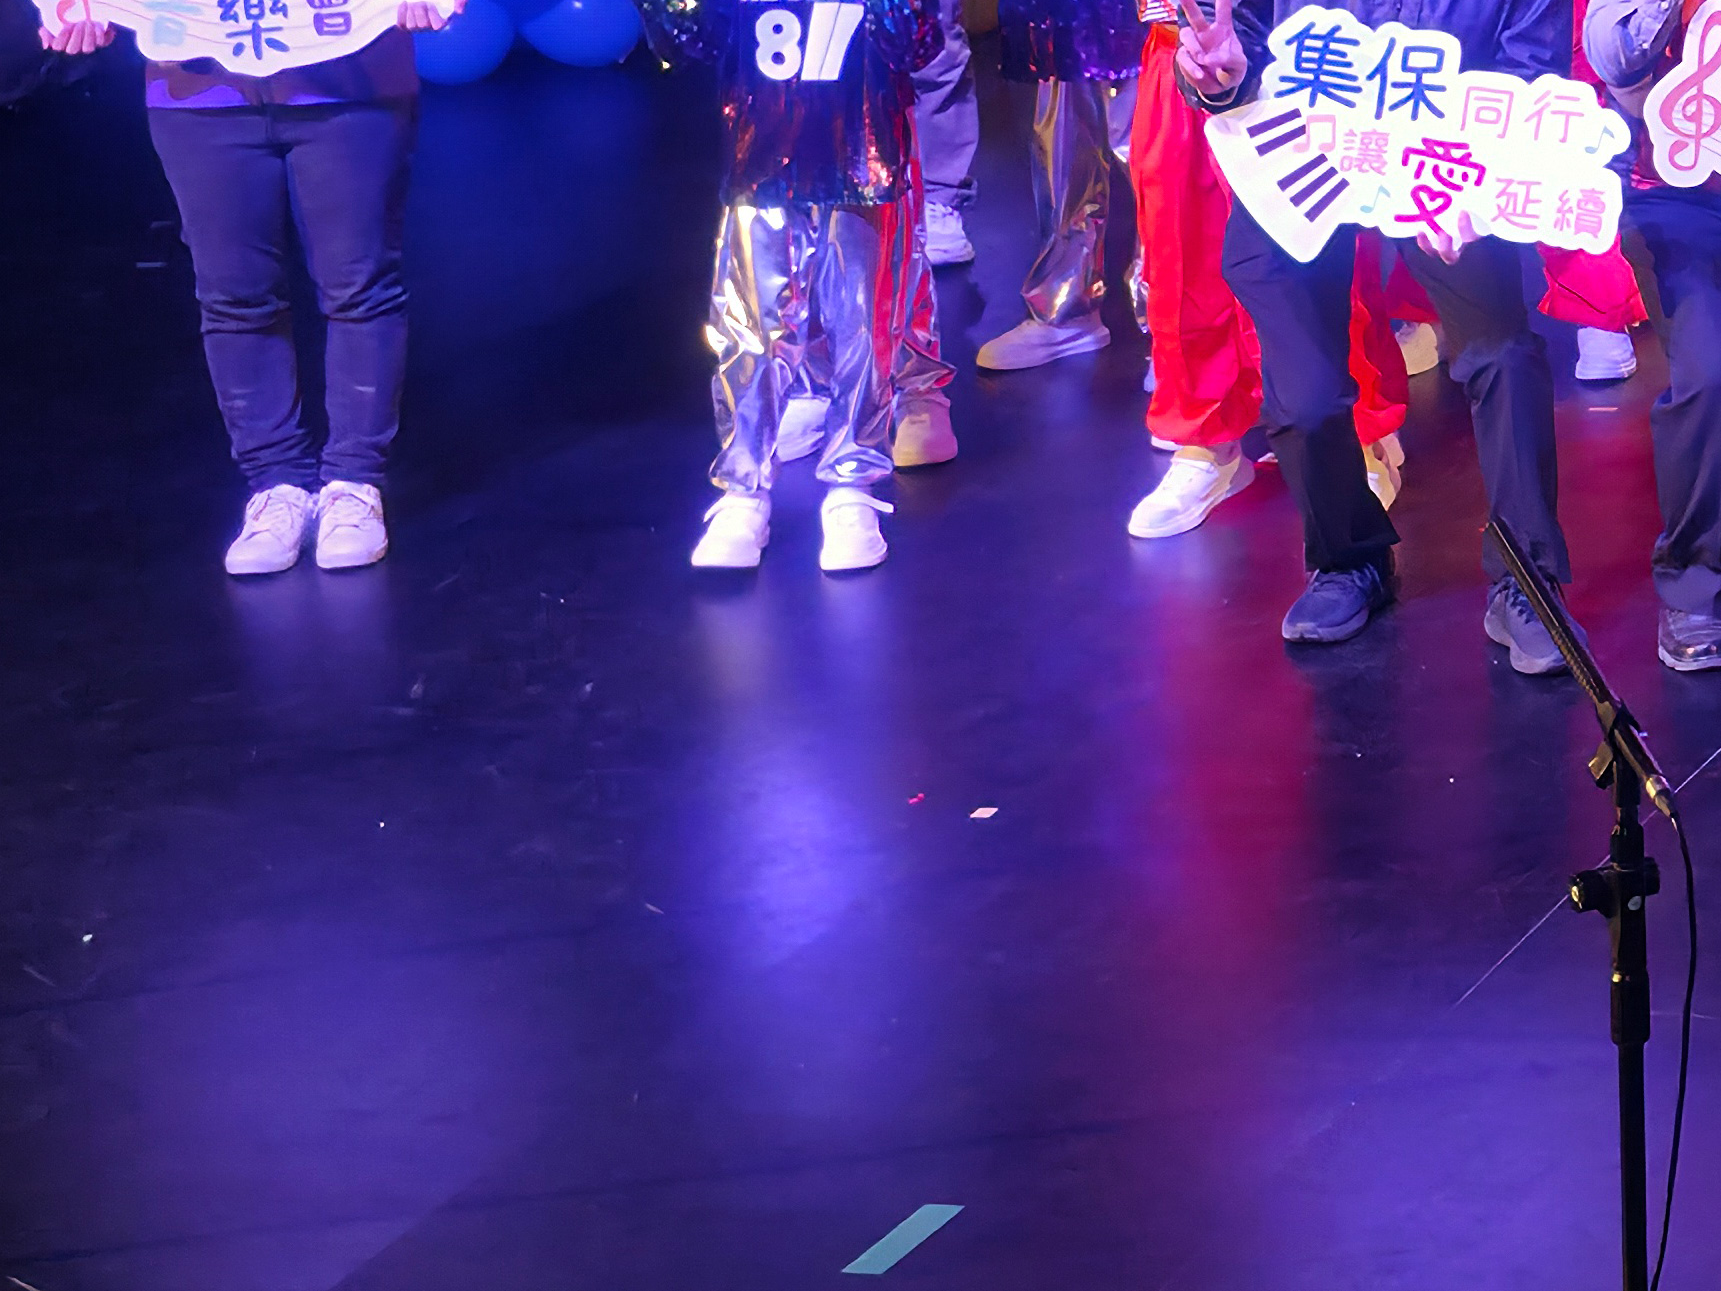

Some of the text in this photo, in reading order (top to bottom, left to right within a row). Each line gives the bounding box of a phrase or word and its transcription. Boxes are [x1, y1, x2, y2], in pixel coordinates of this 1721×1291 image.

[1275, 21, 1585, 144] 集保同行
[1339, 128, 1608, 238] 讓愛延續
